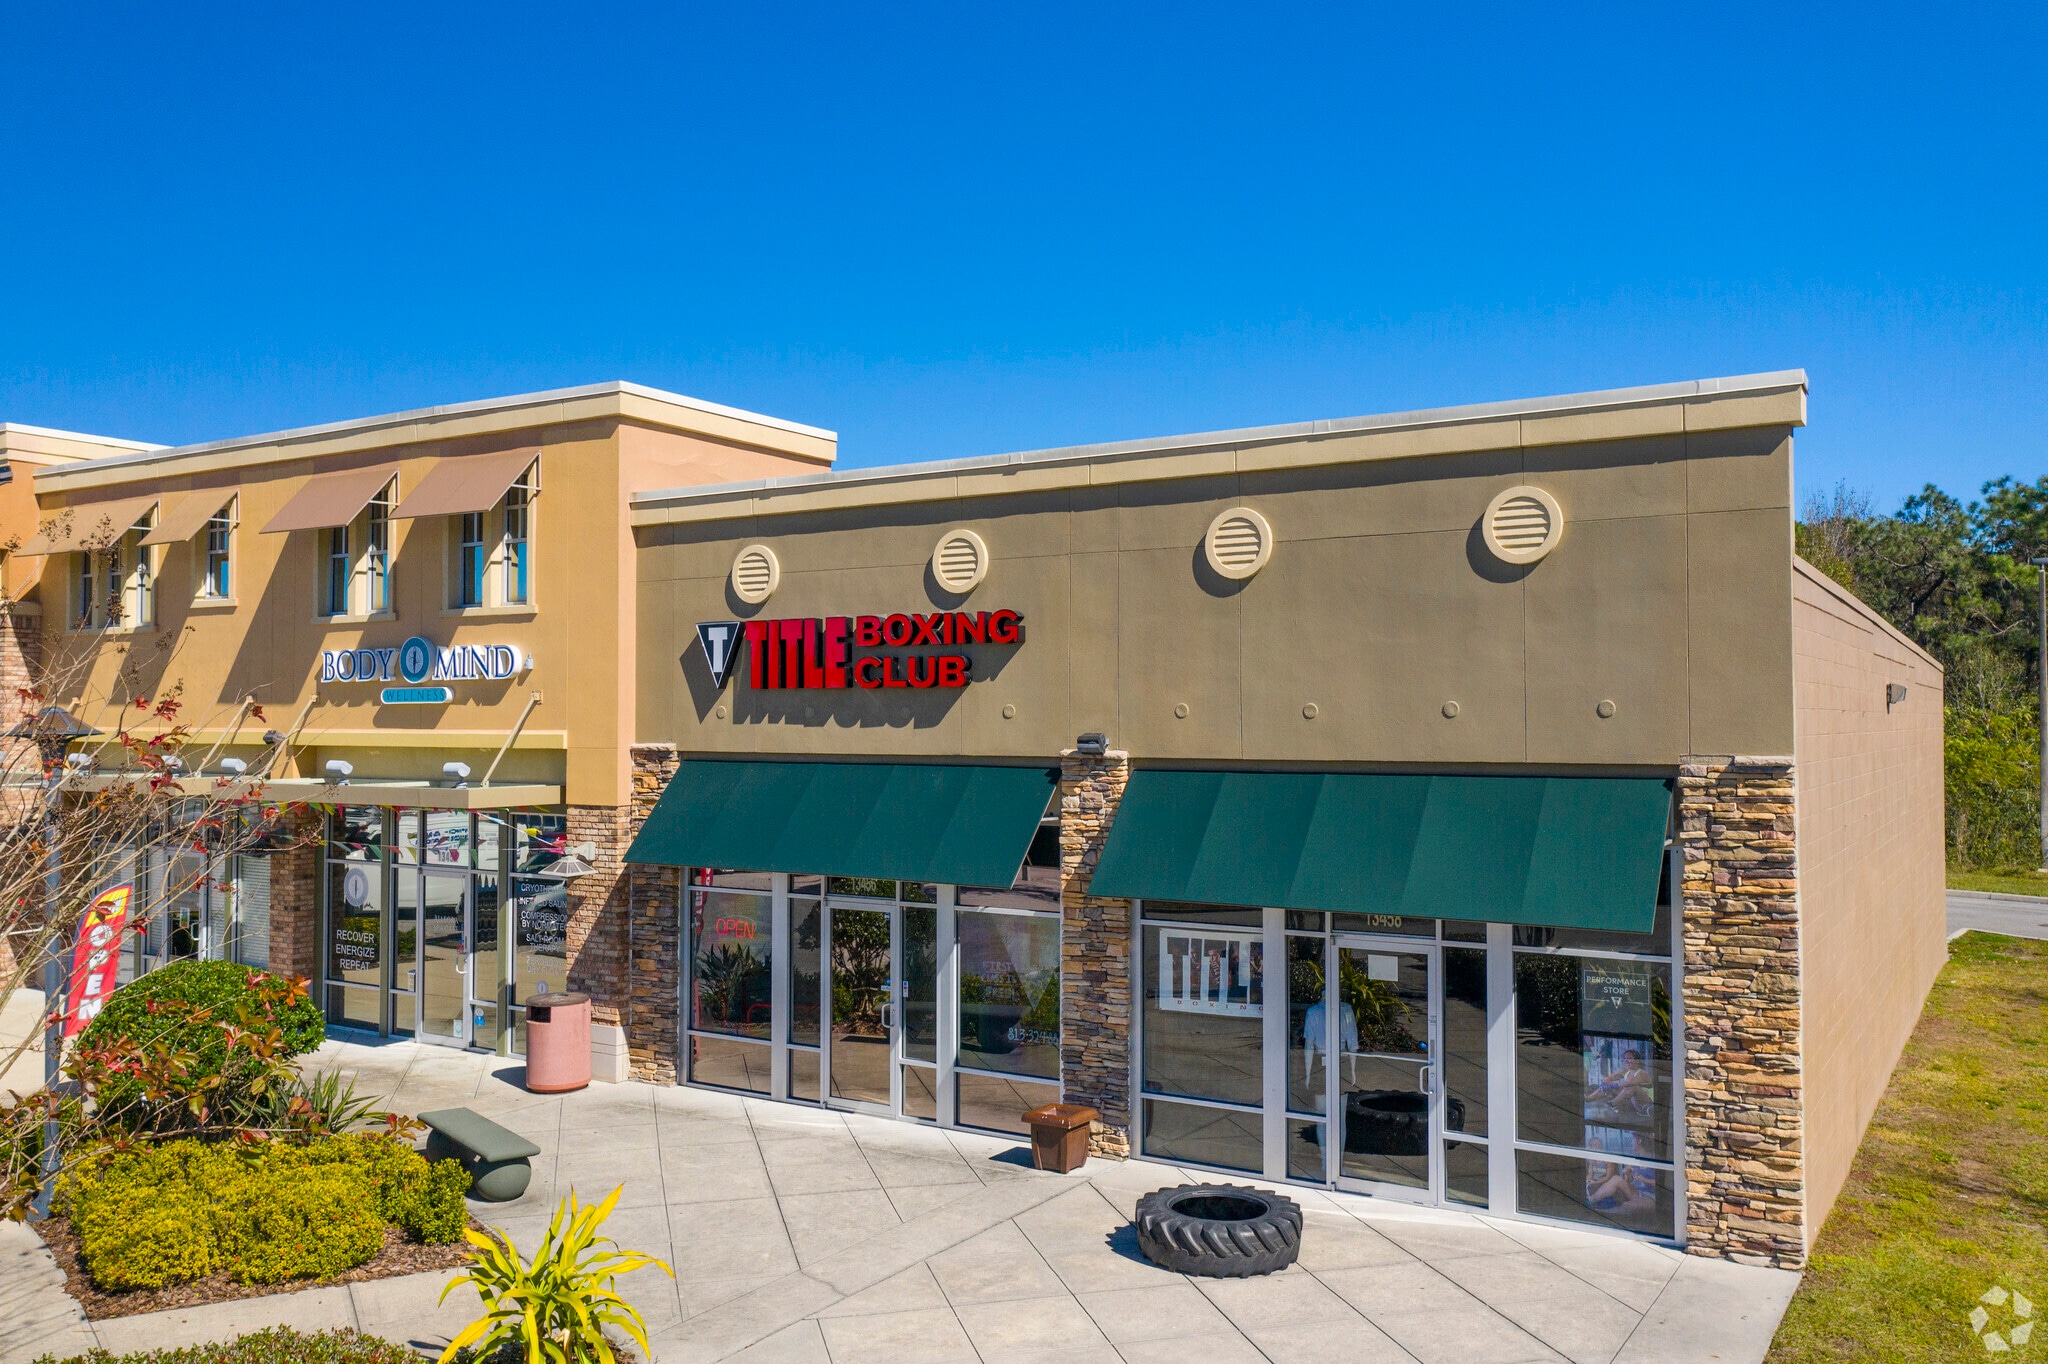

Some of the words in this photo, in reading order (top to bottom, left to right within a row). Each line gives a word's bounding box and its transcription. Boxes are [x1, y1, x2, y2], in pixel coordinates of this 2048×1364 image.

[855, 609, 1020, 647] BOXING
[745, 616, 848, 689] TITLE
[321, 649, 396, 682] BODY
[433, 645, 517, 680] MIND
[853, 654, 968, 689] CLUB
[385, 688, 446, 701] WELLNESS
[521, 919, 530, 928] BY
[532, 921, 566, 931] NORMATE
[715, 917, 755, 940] OPEN
[336, 929, 375, 943] RECOVER
[526, 933, 541, 943] SALT
[543, 935, 565, 945] ROOM
[335, 943, 375, 958] ENERGIZE
[530, 942, 560, 953] THERAPY
[340, 958, 371, 971] REPEAT
[77, 924, 114, 1020] OPEN
[1586, 975, 1646, 987] PERFORMANCE
[1603, 986, 1629, 995] STORE
